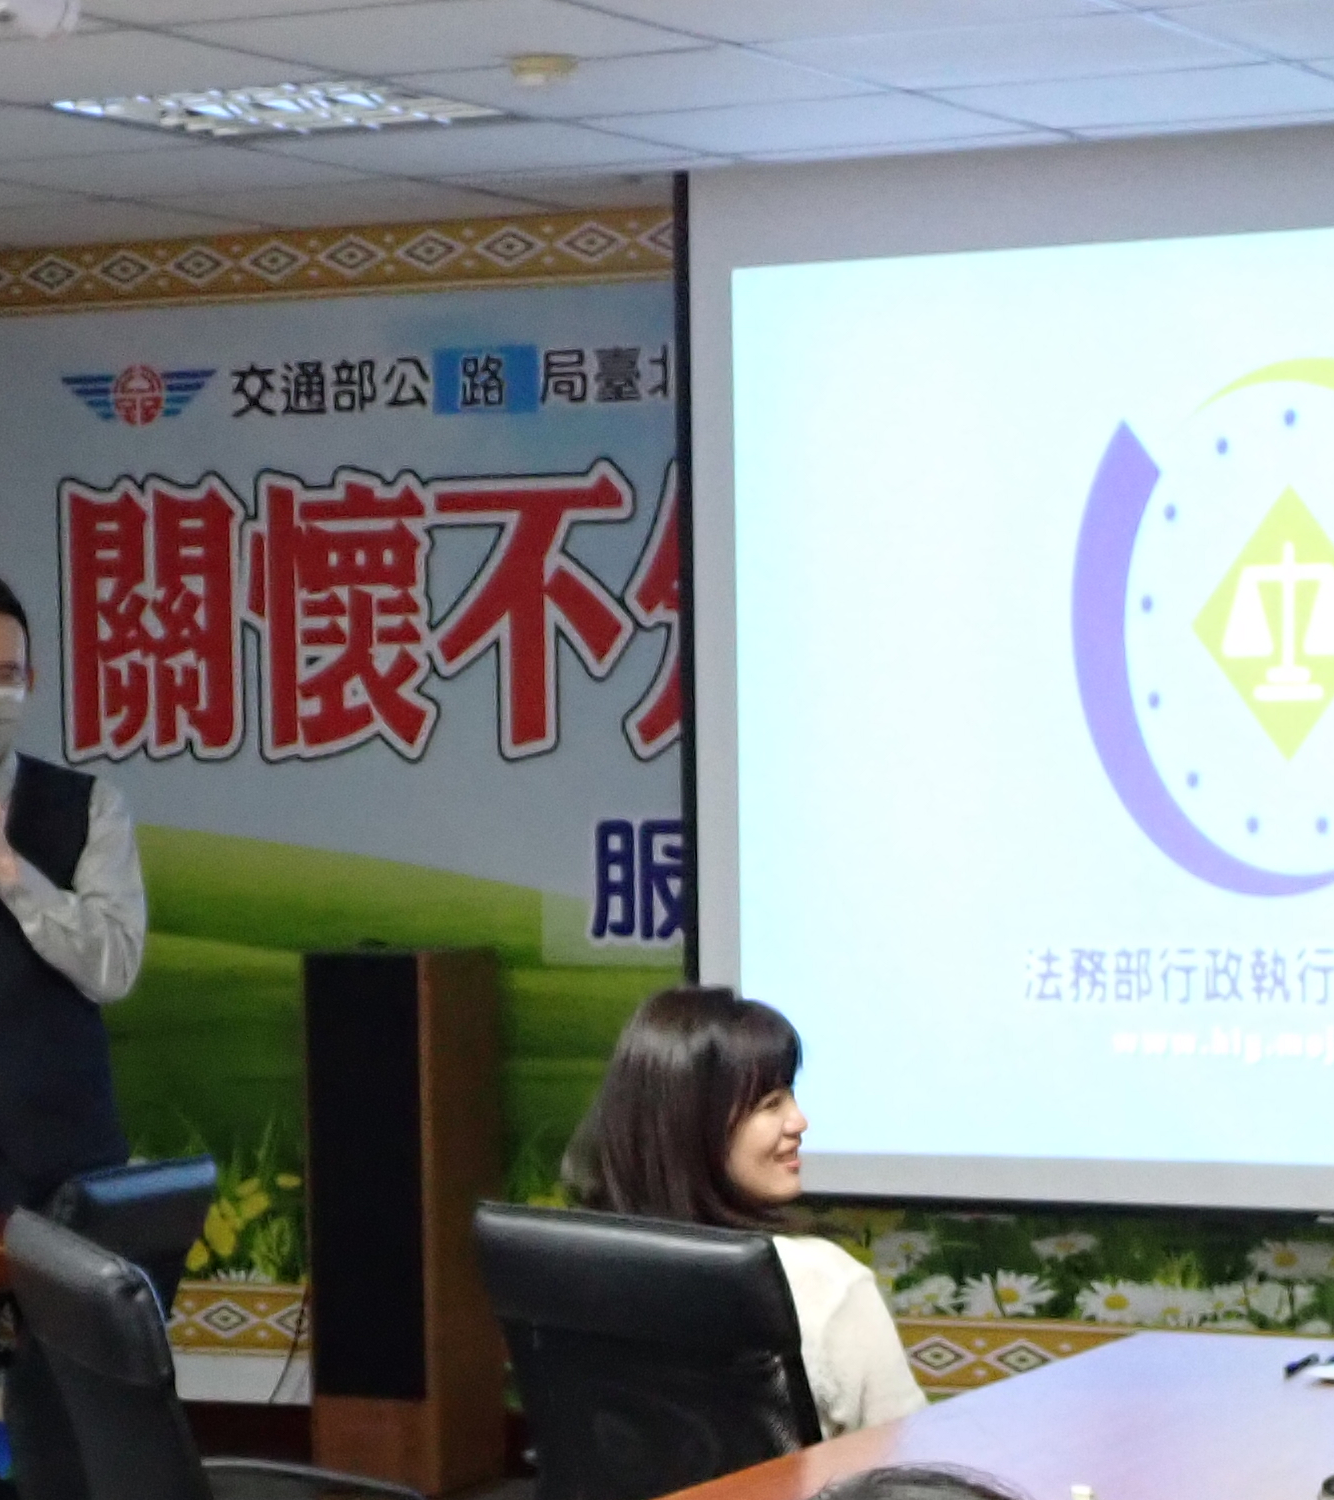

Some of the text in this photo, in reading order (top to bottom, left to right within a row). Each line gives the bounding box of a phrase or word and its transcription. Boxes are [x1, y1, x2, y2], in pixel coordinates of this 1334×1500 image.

[61, 462, 683, 760] 關懷不
[591, 819, 684, 940] 服
